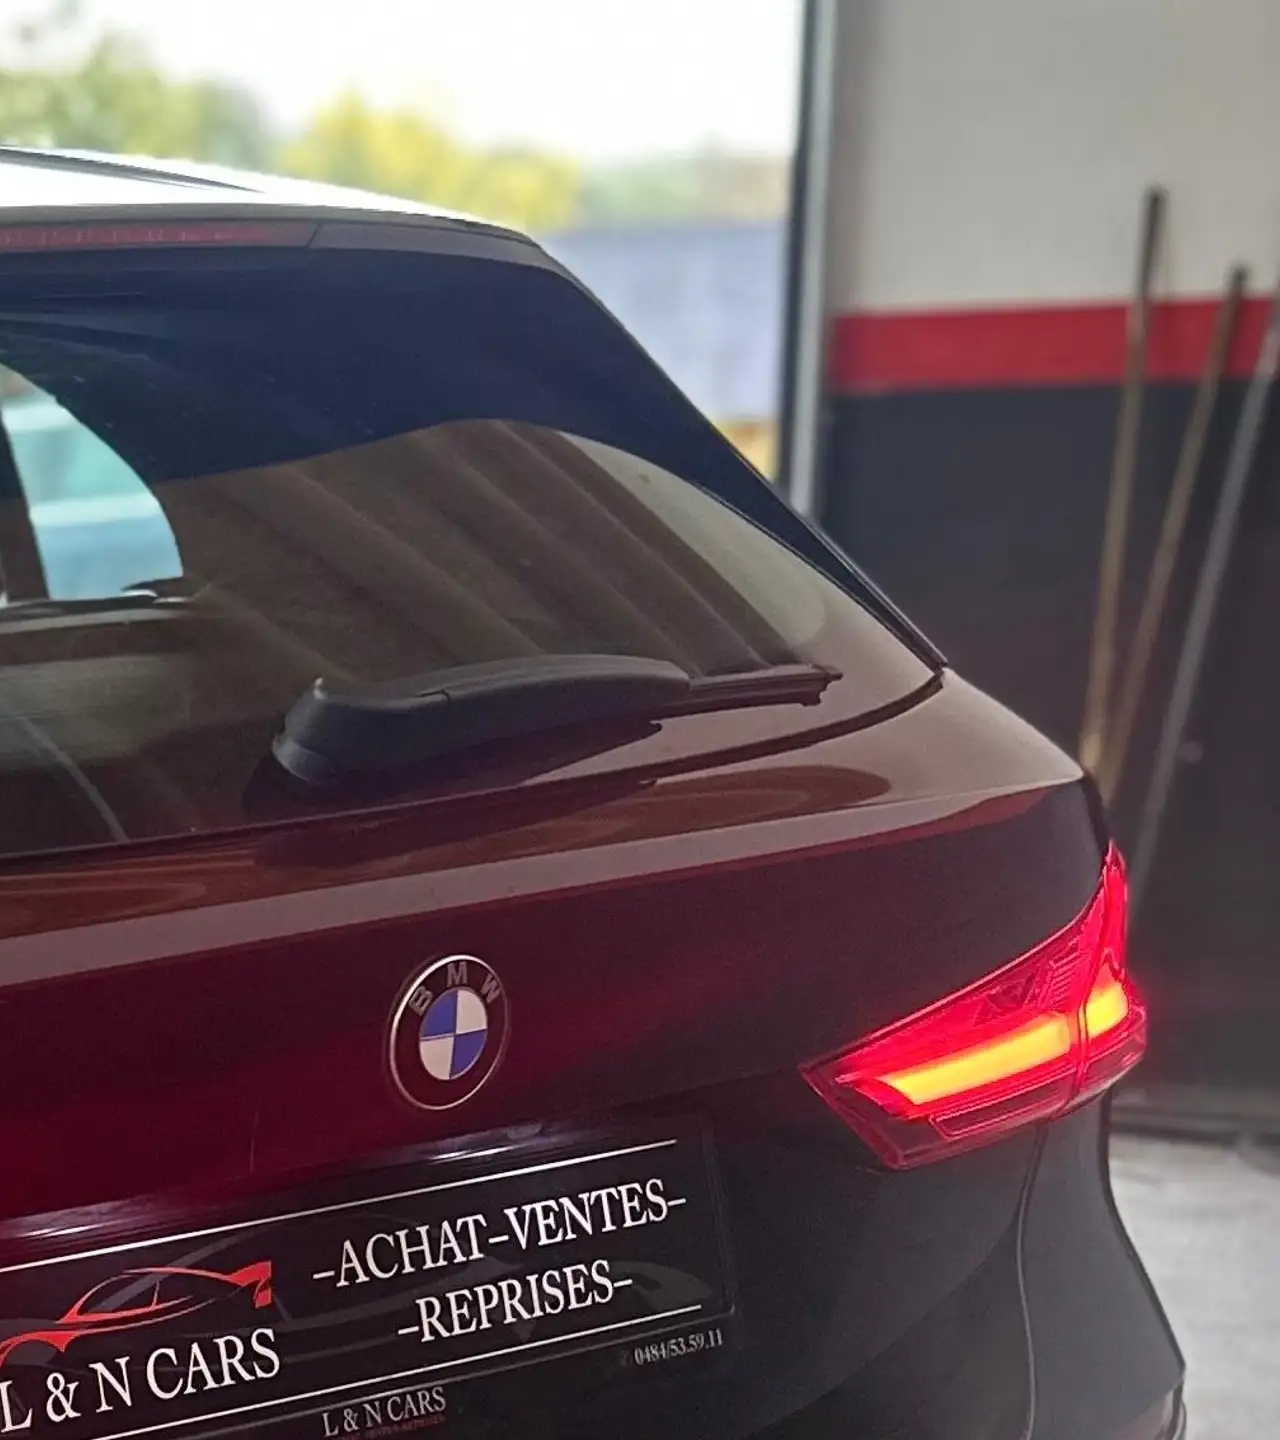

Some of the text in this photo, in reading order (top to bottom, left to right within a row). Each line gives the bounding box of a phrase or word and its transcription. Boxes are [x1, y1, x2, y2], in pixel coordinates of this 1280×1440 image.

[408, 960, 502, 1017] BMW
[312, 1178, 687, 1288] -ACHAT-VENTES-
[397, 1259, 633, 1342] -REPRISES-
[45, 1372, 82, 1423] &
[89, 1356, 133, 1413] N
[146, 1328, 280, 1400] CARS
[322, 1411, 339, 1437] L
[343, 1408, 360, 1433] &
[363, 1401, 382, 1428] N
[387, 1386, 446, 1422] CARS
